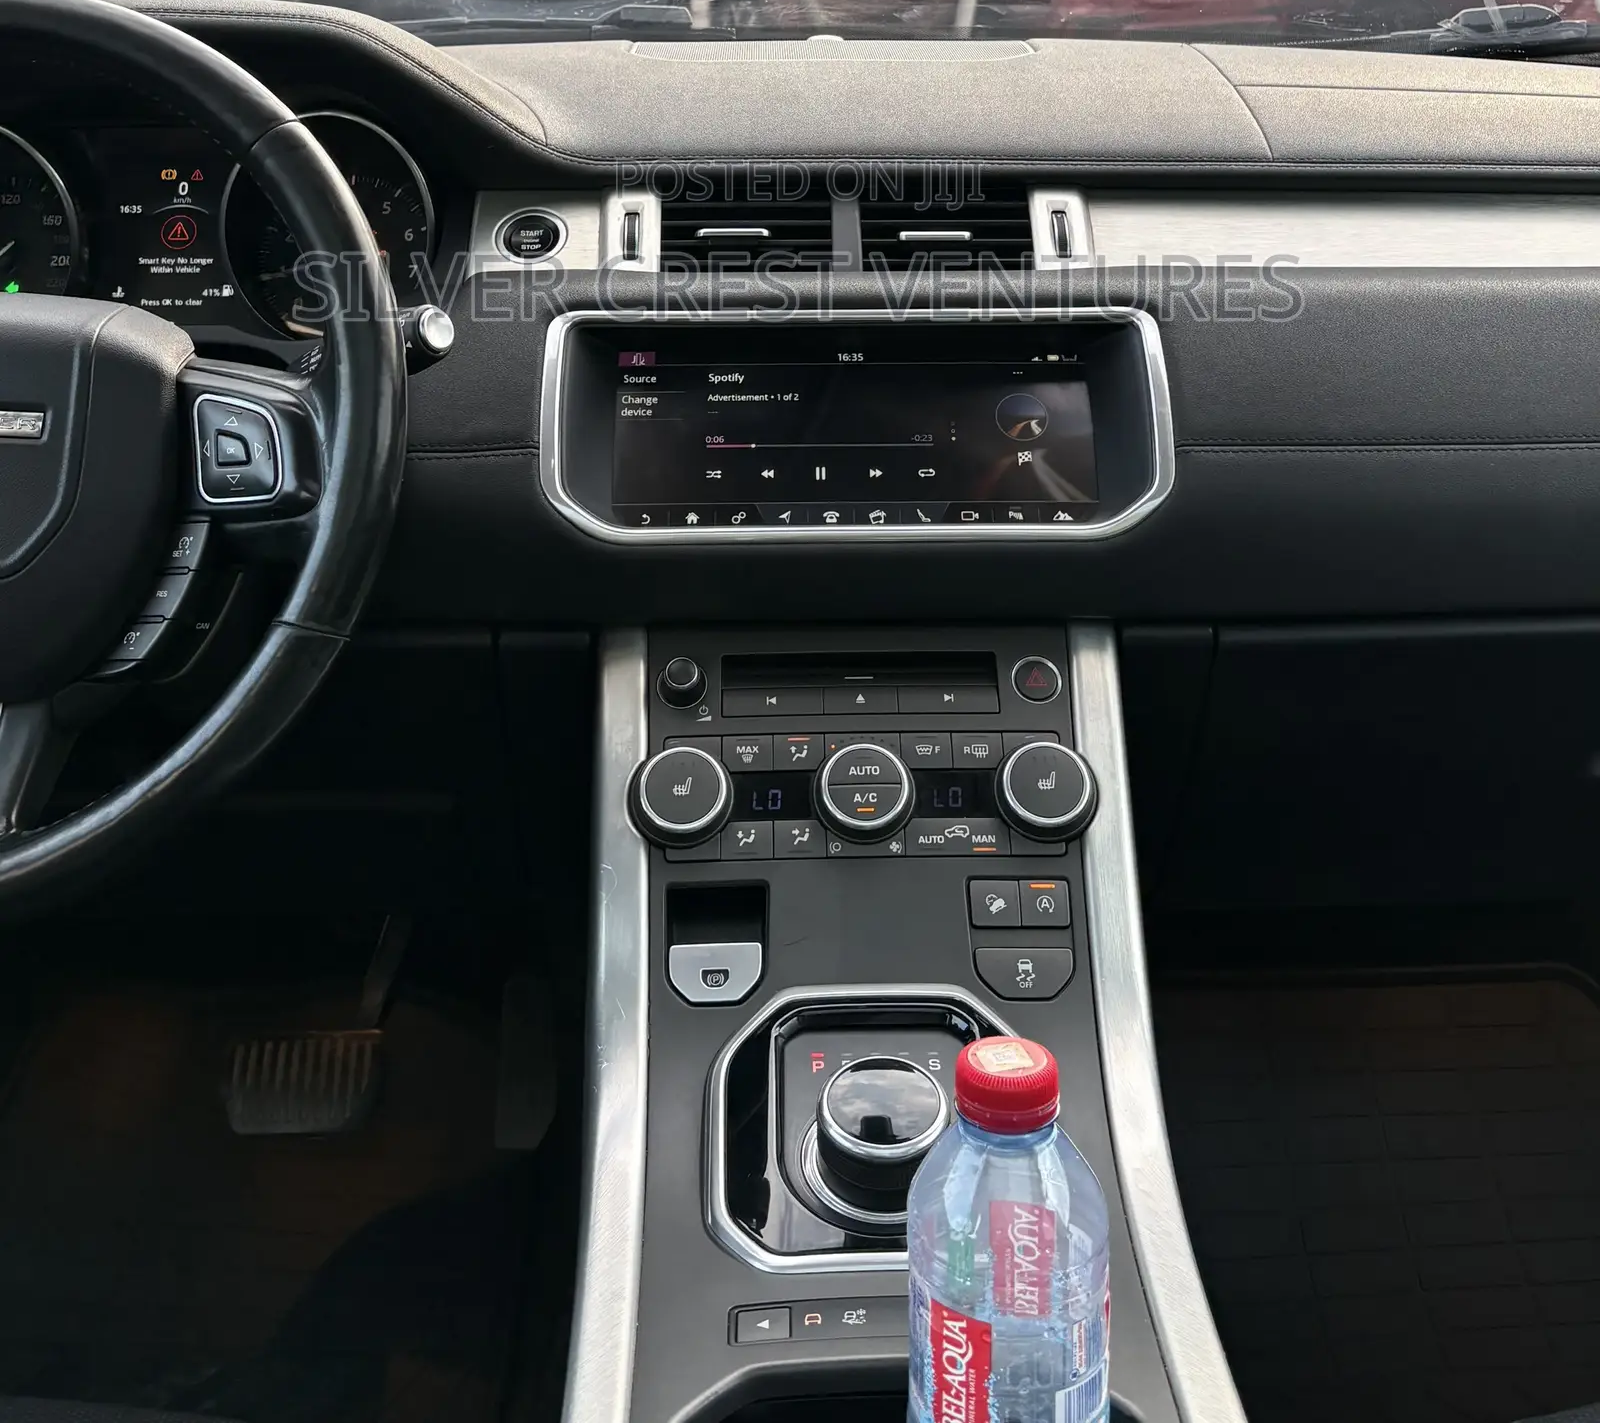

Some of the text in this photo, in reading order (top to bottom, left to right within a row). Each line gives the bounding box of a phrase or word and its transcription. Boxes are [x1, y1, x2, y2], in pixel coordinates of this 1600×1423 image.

[178, 181, 189, 196] 0
[1, 194, 21, 205] 120
[119, 205, 142, 214] 16:35
[382, 202, 391, 214] 5
[404, 229, 414, 241] 6
[520, 229, 544, 237] START
[138, 257, 159, 265] Smart
[161, 257, 175, 267] Key
[190, 257, 214, 267] Longer
[408, 265, 418, 278] 7
[202, 288, 220, 297] 41%
[837, 353, 864, 362] 16:35
[623, 375, 657, 384] Source
[708, 373, 745, 384] Spotify
[621, 395, 659, 407] Change
[707, 393, 769, 402] Advertisement
[782, 393, 792, 401] of
[793, 393, 800, 401] 2
[621, 407, 653, 417] device
[705, 436, 725, 444] 0:06
[911, 434, 933, 442] -0:23
[156, 590, 168, 598] RES
[736, 746, 759, 754] MAX
[935, 746, 941, 754] F
[849, 766, 880, 775] AUTO
[853, 792, 877, 803] A/C
[918, 835, 945, 844] AUTO
[972, 835, 996, 843] MAN
[1019, 981, 1033, 989] OFF
[812, 1061, 825, 1073] P
[929, 1059, 941, 1070] S
